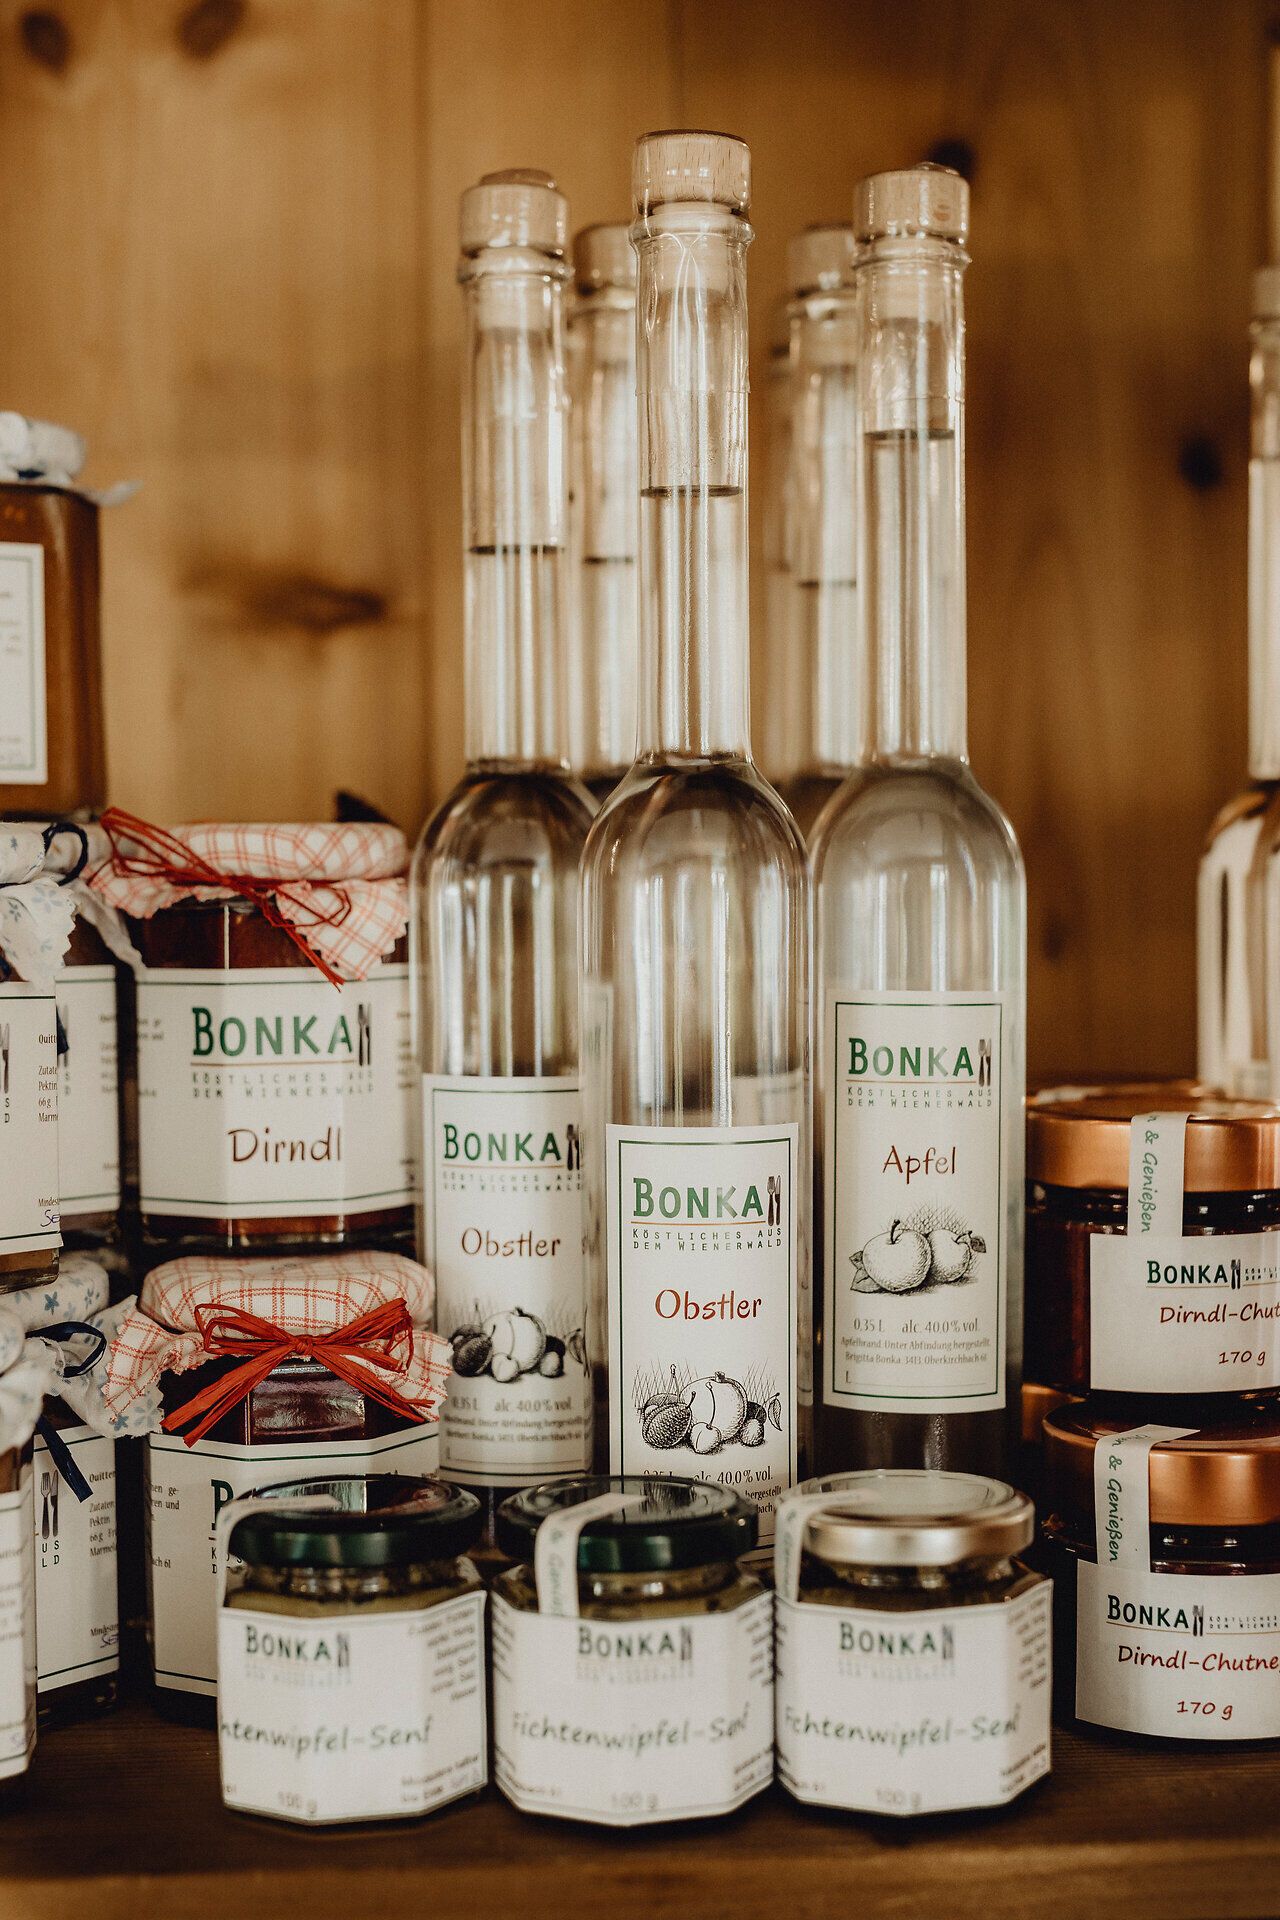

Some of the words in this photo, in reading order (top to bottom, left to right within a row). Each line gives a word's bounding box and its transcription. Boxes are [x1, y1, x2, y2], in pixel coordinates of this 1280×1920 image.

[38, 1034, 57, 1045] Quitt
[192, 1007, 353, 1056] BONKA
[848, 1037, 974, 1077] BONKA
[848, 1087, 953, 1098] KÖSTLICHES
[968, 1088, 992, 1098] AUS
[848, 1098, 874, 1108] DEM
[891, 1099, 992, 1109] WIENERWALD
[228, 1126, 341, 1163] Dirndl
[444, 1124, 562, 1162] BONKA
[1145, 1129, 1160, 1145] &
[882, 1145, 956, 1184] Apfel
[633, 1177, 764, 1219] BONKA
[1141, 1152, 1158, 1233] Genießen
[461, 1227, 561, 1257] Obstler
[632, 1229, 741, 1241] KÖSTLICHES
[758, 1228, 781, 1238] AUS
[633, 1241, 661, 1250] DEM
[678, 1239, 782, 1251] WIENERWALD
[1147, 1260, 1229, 1284] BONKA
[655, 1289, 762, 1320] Obstler
[1218, 1350, 1252, 1365] 170
[1257, 1351, 1266, 1367] g
[717, 1470, 753, 1485] 40,0%
[755, 1466, 774, 1481] vol.
[1108, 1455, 1123, 1471] &
[165, 1500, 180, 1510] und
[1105, 1478, 1123, 1562] Genießen
[1107, 1594, 1190, 1629] BONKA
[246, 1625, 331, 1661] BONKA
[578, 1626, 676, 1657] BONKA
[840, 1622, 936, 1655] BONKA
[1118, 1645, 1280, 1674] Dirndl-Chutne
[1176, 1701, 1216, 1715] 170
[1221, 1705, 1233, 1721] g
